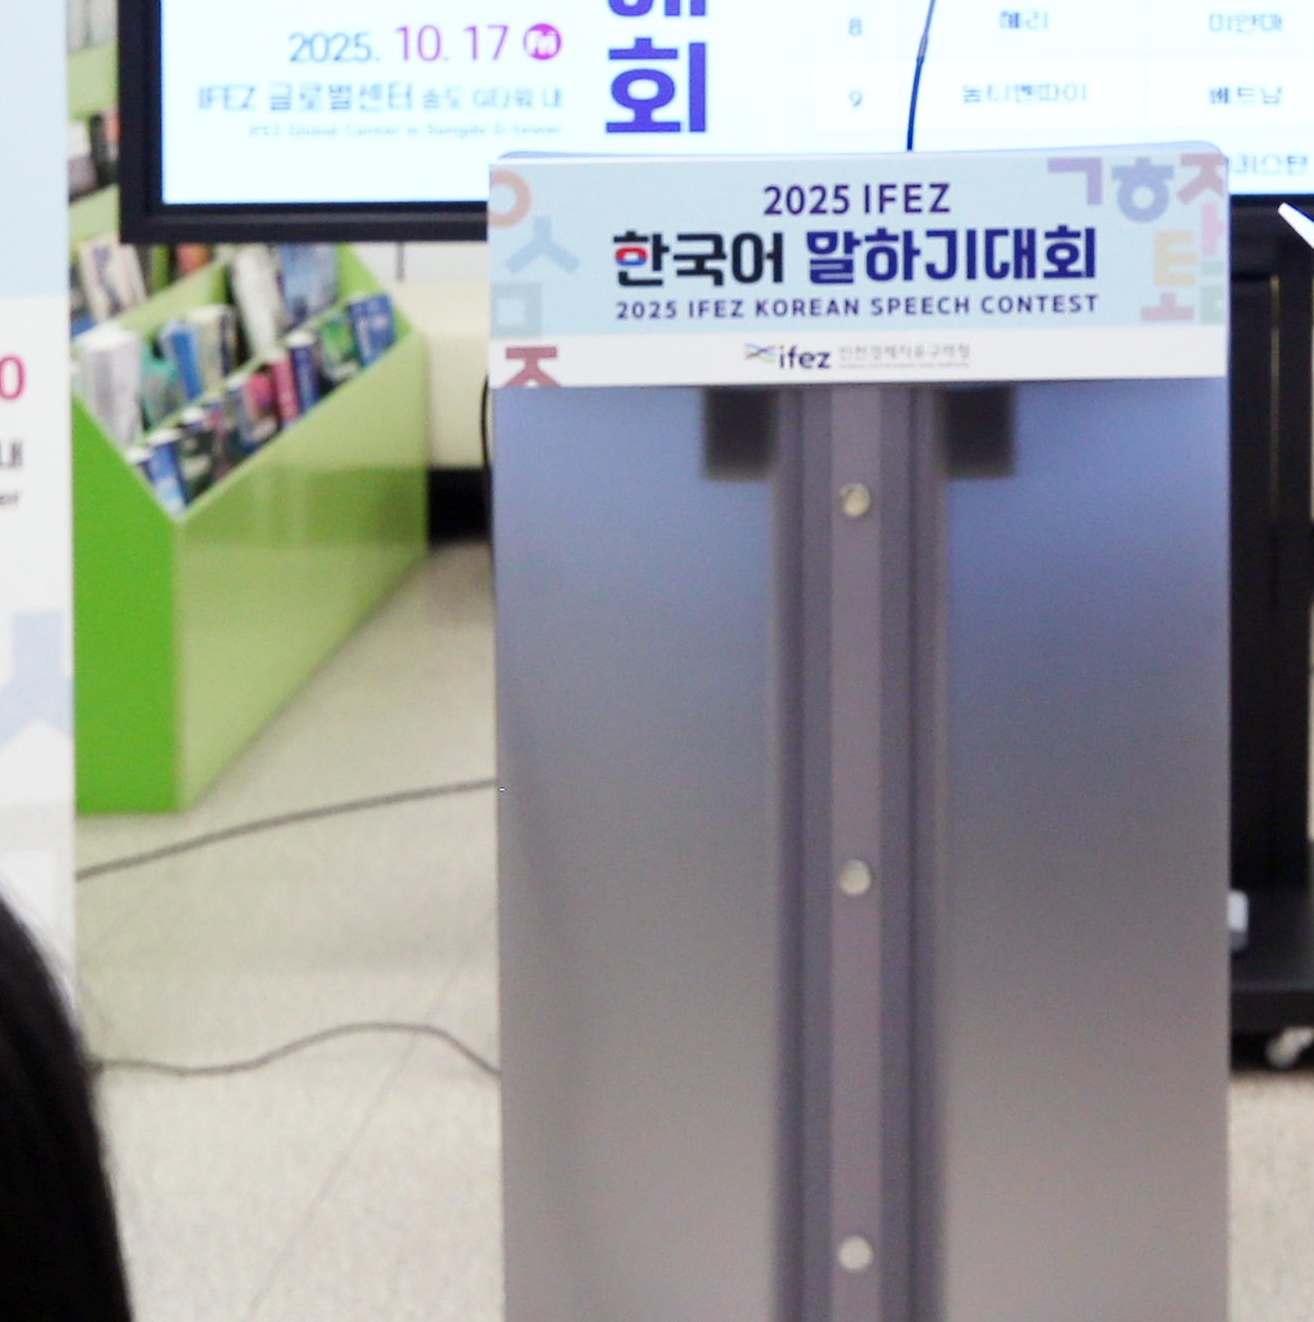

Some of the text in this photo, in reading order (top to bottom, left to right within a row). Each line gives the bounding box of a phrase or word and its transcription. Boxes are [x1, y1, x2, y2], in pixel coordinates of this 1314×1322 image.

[848, 17, 863, 36] 8
[1209, 13, 1283, 34] 미얀마
[289, 32, 379, 63] 2025.
[396, 25, 447, 62] 10.
[464, 24, 509, 61] 17
[198, 85, 256, 110] IFEZ
[269, 82, 412, 112] 글로벌센터
[849, 91, 863, 108] 9
[1210, 87, 1281, 105] 베트남
[764, 183, 950, 216] 2025 IFEZ
[613, 224, 1096, 287] 한국어 말하기대회
[617, 294, 1097, 320] 2025 IFEZ KOREAN SPEECH CONTEST
[780, 345, 831, 369] ifez
